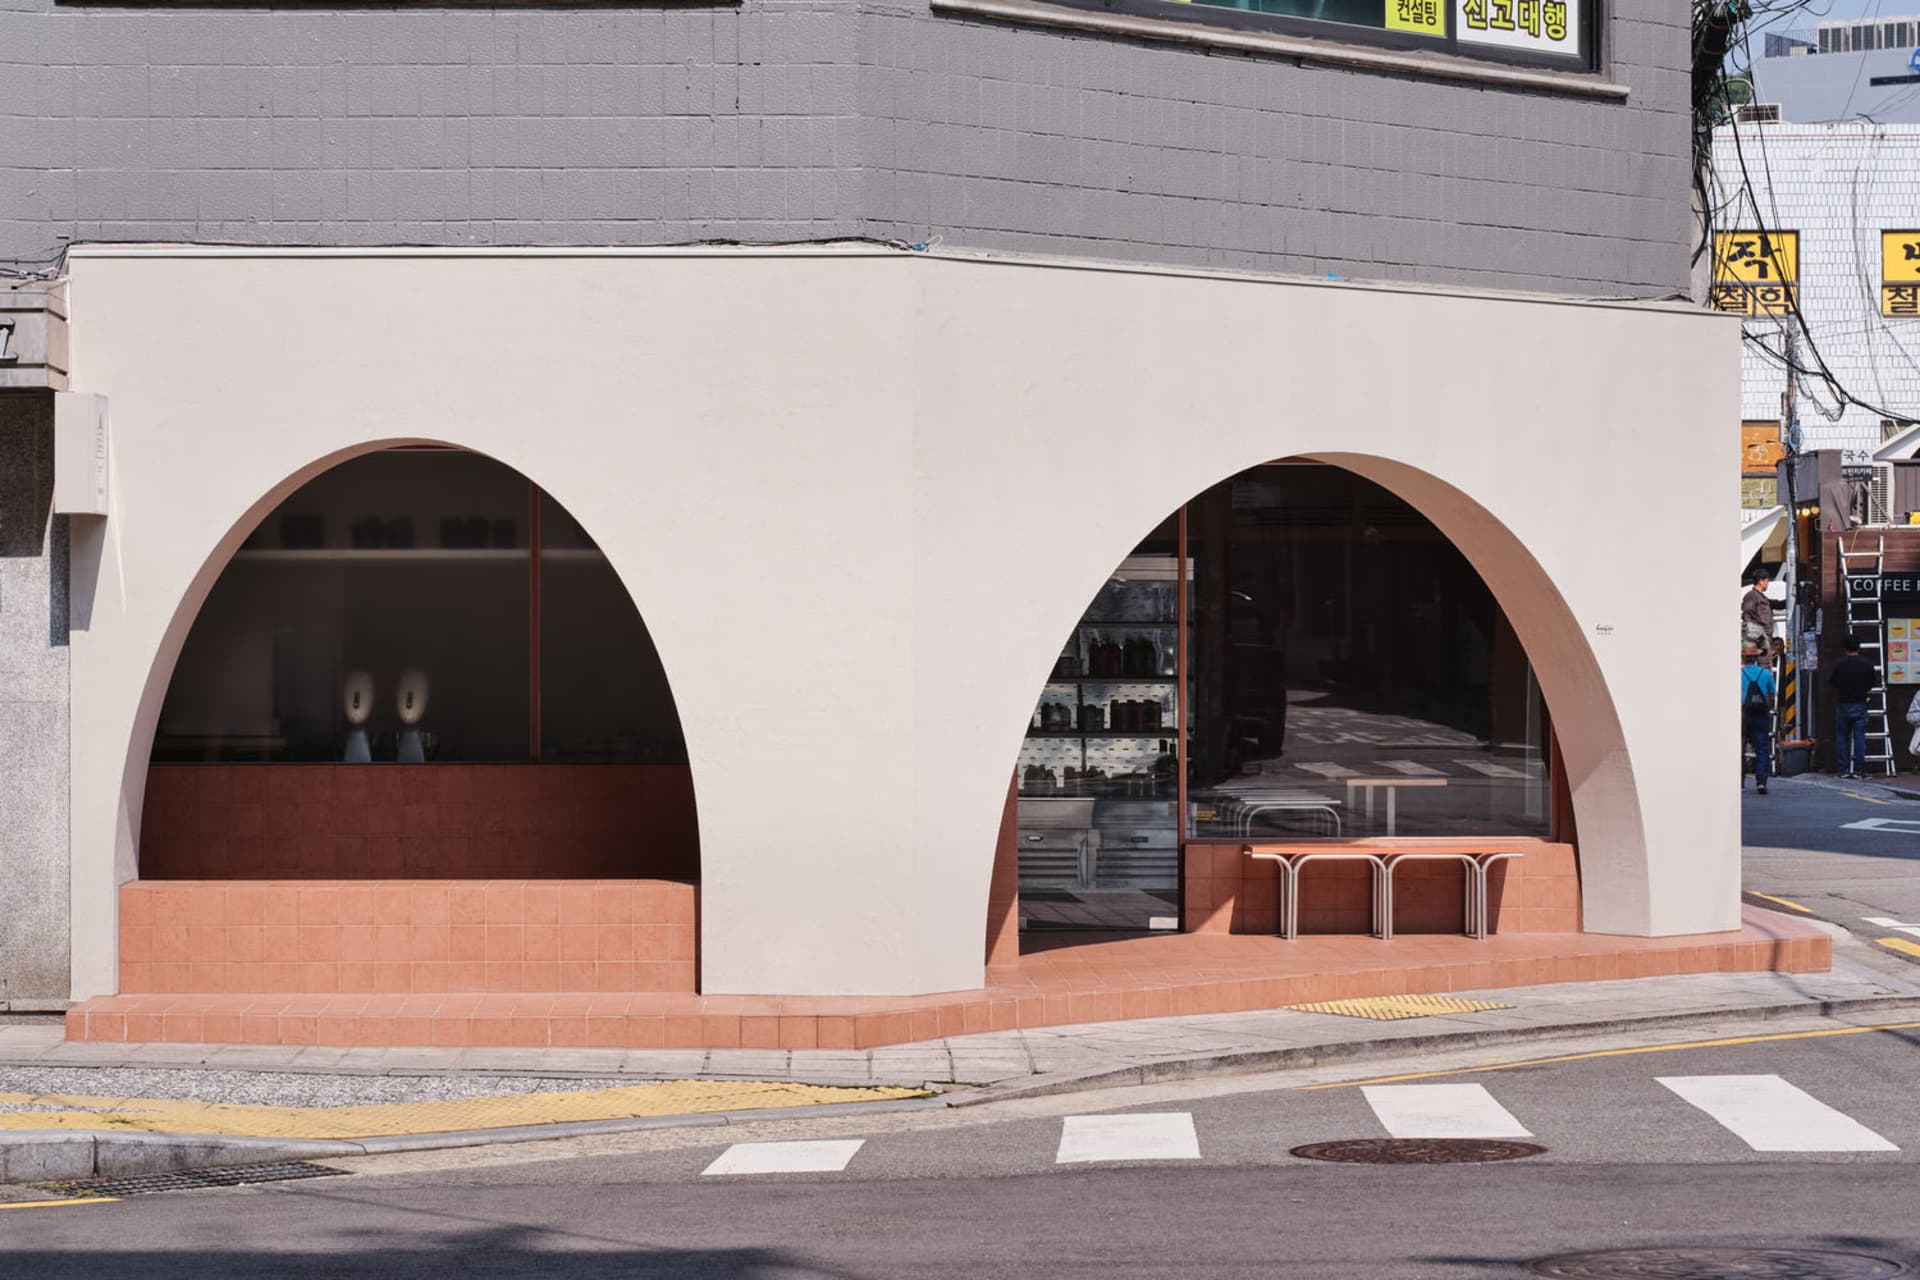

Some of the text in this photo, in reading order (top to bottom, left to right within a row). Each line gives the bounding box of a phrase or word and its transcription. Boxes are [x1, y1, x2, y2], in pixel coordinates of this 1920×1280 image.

[1397, 0, 1437, 26] 컨설팅
[1463, 0, 1567, 41] 신고대행
[1728, 235, 1782, 279] 작
[1718, 287, 1791, 314] 철학
[1853, 579, 1911, 591] COFEE
